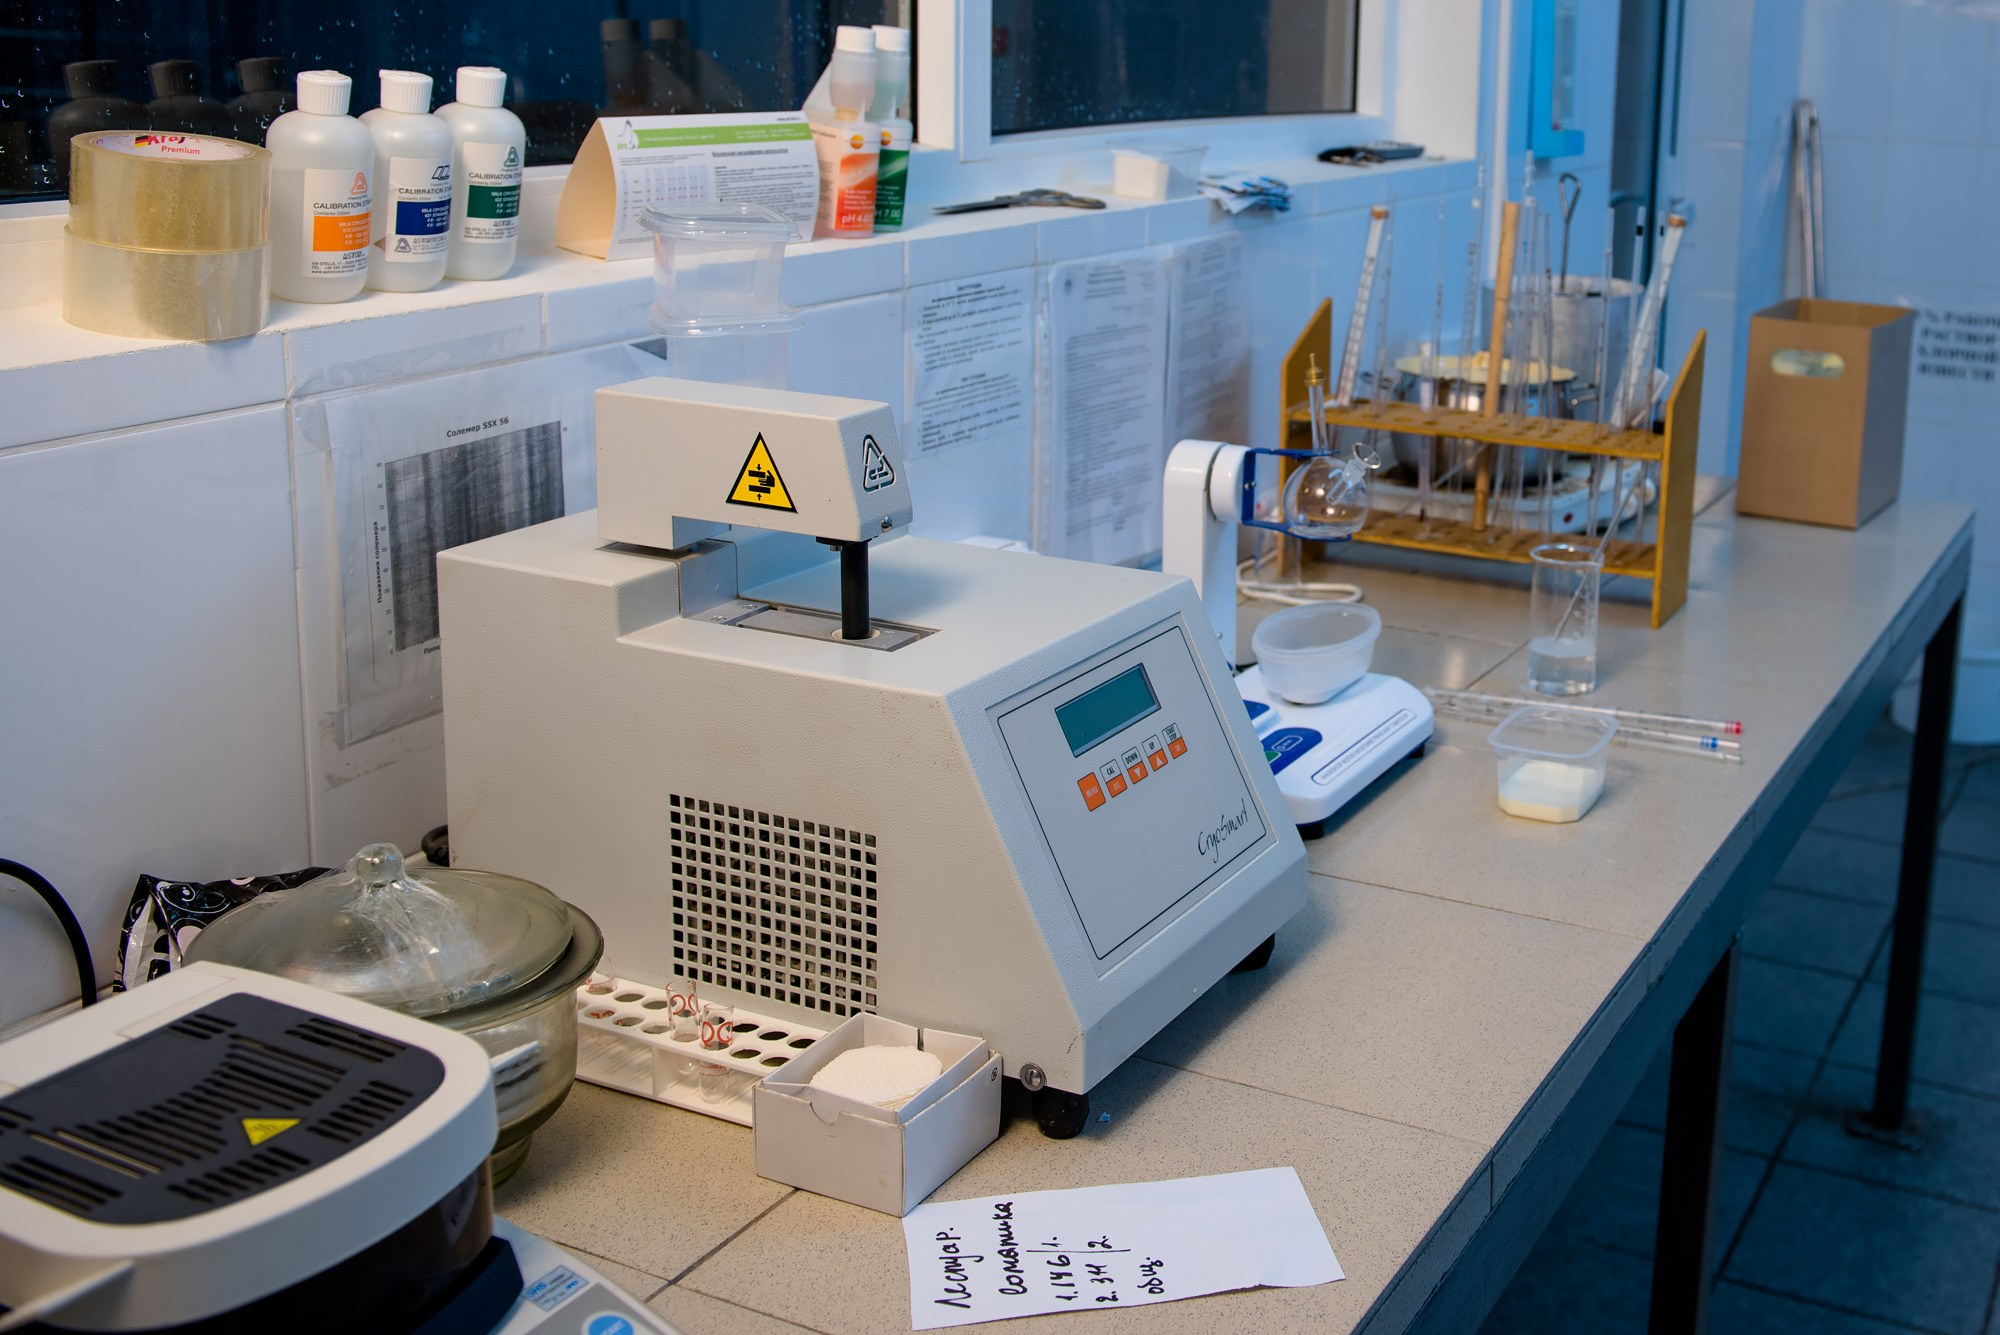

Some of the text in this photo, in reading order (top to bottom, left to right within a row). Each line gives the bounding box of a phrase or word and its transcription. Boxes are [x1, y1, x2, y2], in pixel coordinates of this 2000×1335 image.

[161, 146, 200, 155] Premium
[468, 172, 513, 180] CALIBRATION
[313, 201, 362, 209] CALIBRATION
[446, 416, 509, 438] Солемер SSX 56
[373, 521, 383, 604] Показания солемера
[1165, 725, 1176, 736] START
[1168, 732, 1177, 742] STOP
[1148, 741, 1155, 750] UP
[1125, 752, 1139, 765] DOWN
[1106, 766, 1115, 776] CAL
[1085, 786, 1099, 798] MENU
[1198, 798, 1249, 864] CryoSmart
